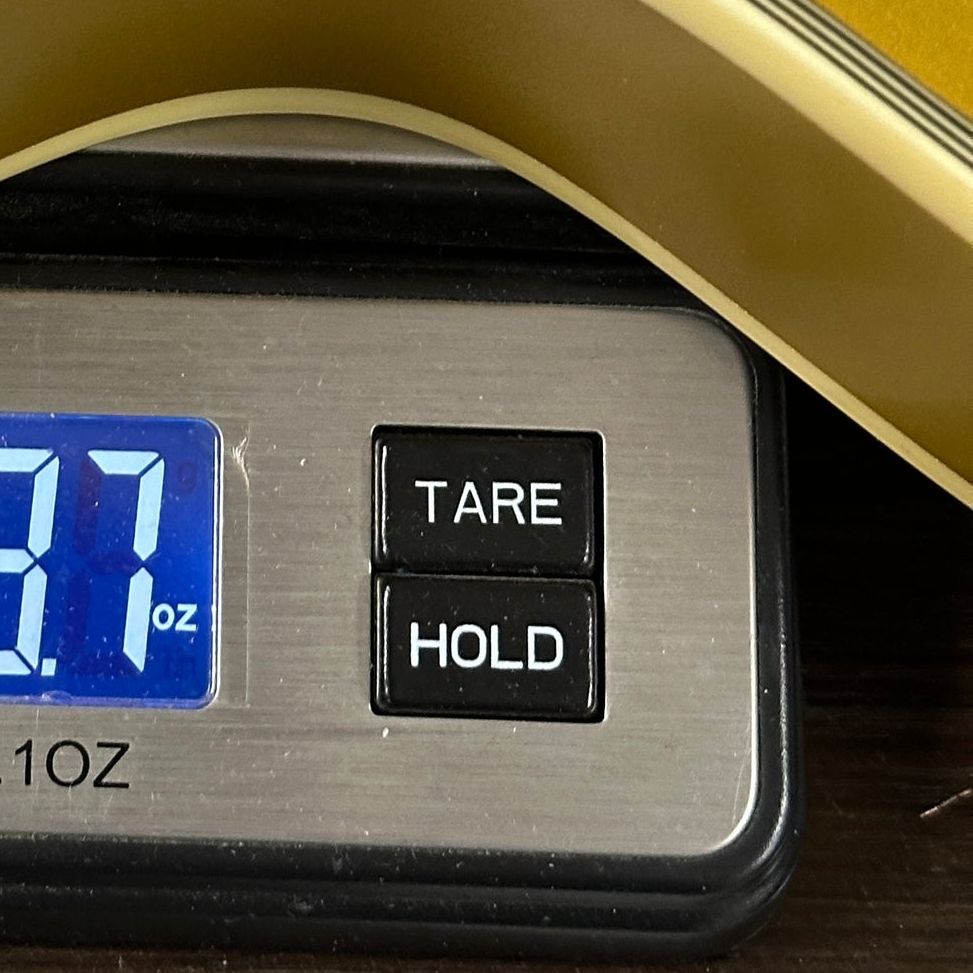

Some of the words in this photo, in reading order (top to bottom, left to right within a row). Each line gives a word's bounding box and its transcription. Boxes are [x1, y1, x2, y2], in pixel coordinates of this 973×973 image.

[414, 480, 563, 525] TARE
[152, 603, 197, 632] oz
[410, 621, 564, 671] HOLD
